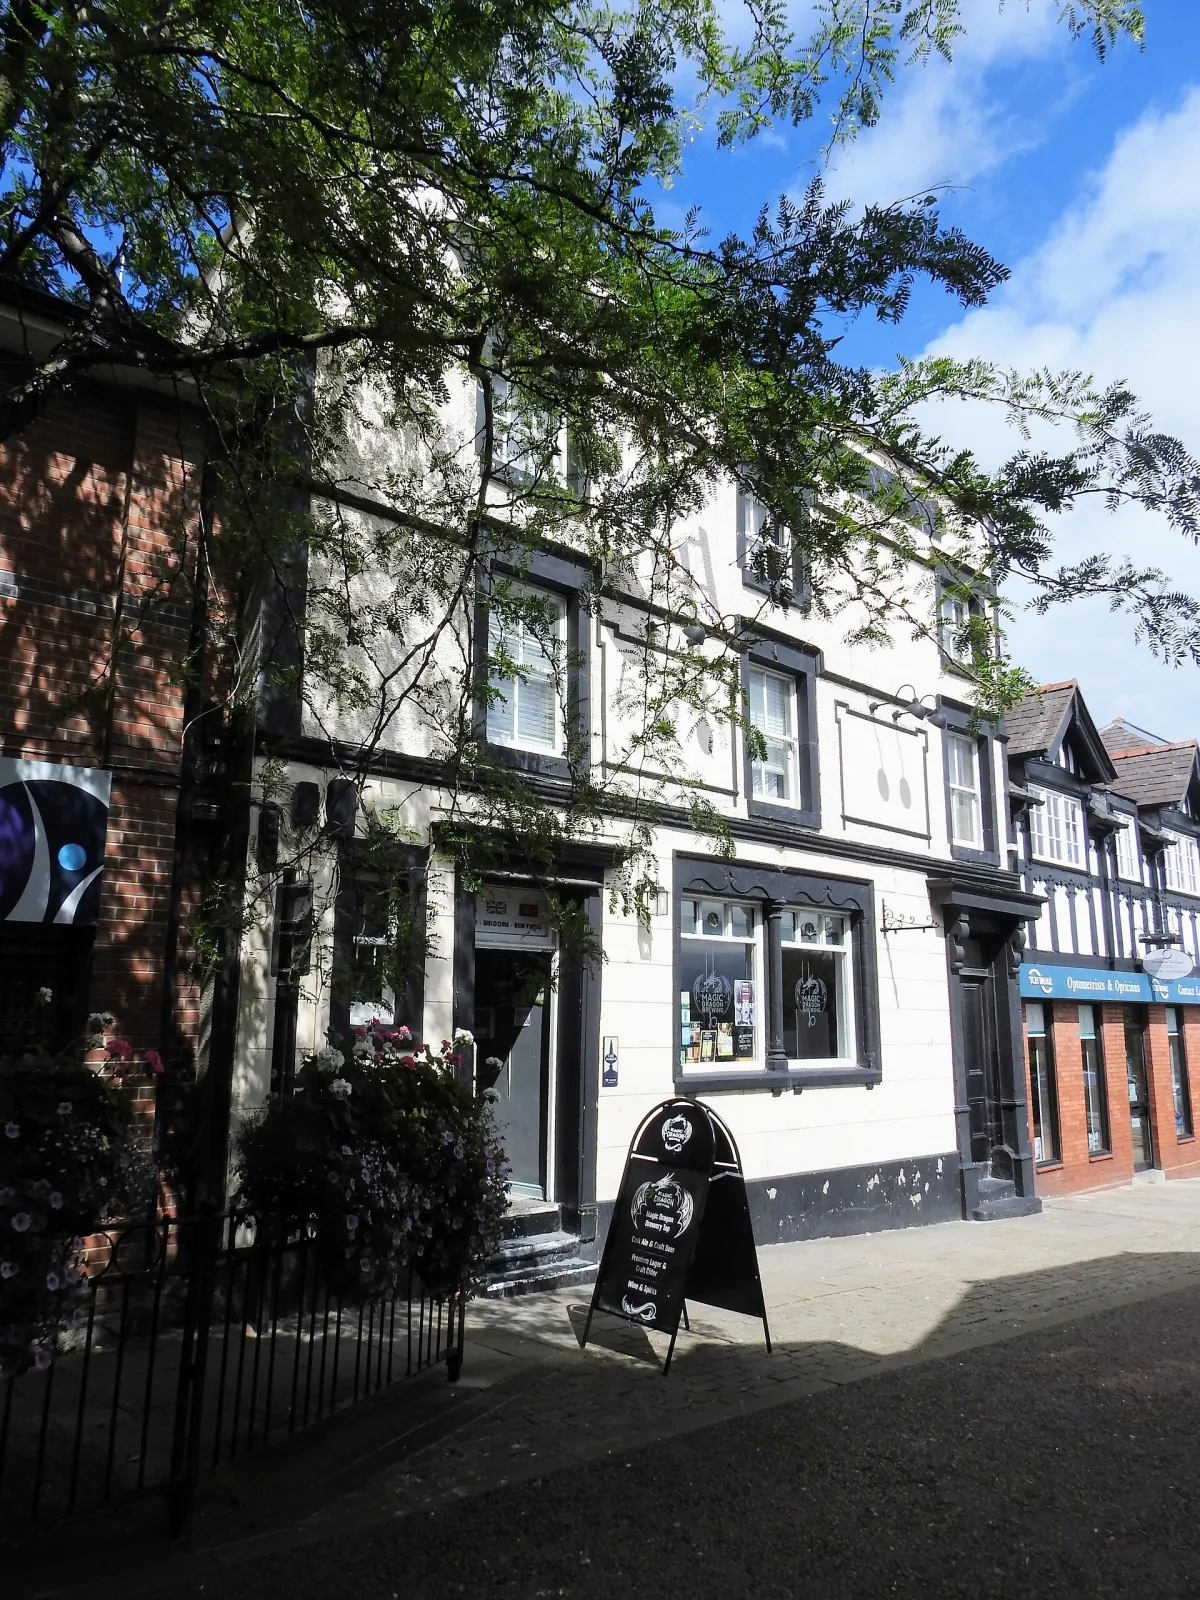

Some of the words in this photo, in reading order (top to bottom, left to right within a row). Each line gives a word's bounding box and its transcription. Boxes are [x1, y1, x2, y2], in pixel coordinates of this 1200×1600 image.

[1067, 976, 1105, 992] Optometrists
[1107, 979, 1113, 991] &
[1114, 979, 1140, 994] Opticians
[701, 993, 724, 1001] MAGIC
[801, 994, 821, 1002] MAGIC
[653, 1194, 675, 1207] DRAGON
[645, 1210, 659, 1220] Magic
[658, 1213, 675, 1223] Dragon
[644, 1219, 663, 1231] Brewery
[640, 1237, 649, 1247] Ale
[648, 1240, 654, 1248] &
[653, 1241, 665, 1251] Craft
[664, 1244, 676, 1253] Beer
[631, 1253, 650, 1265] Premium
[649, 1258, 662, 1269] Lager
[661, 1262, 667, 1270] &
[635, 1264, 646, 1274] Craft
[645, 1267, 658, 1277] Cider
[627, 1279, 639, 1290] Wine
[638, 1283, 644, 1291] &
[643, 1284, 657, 1295] Spirits
